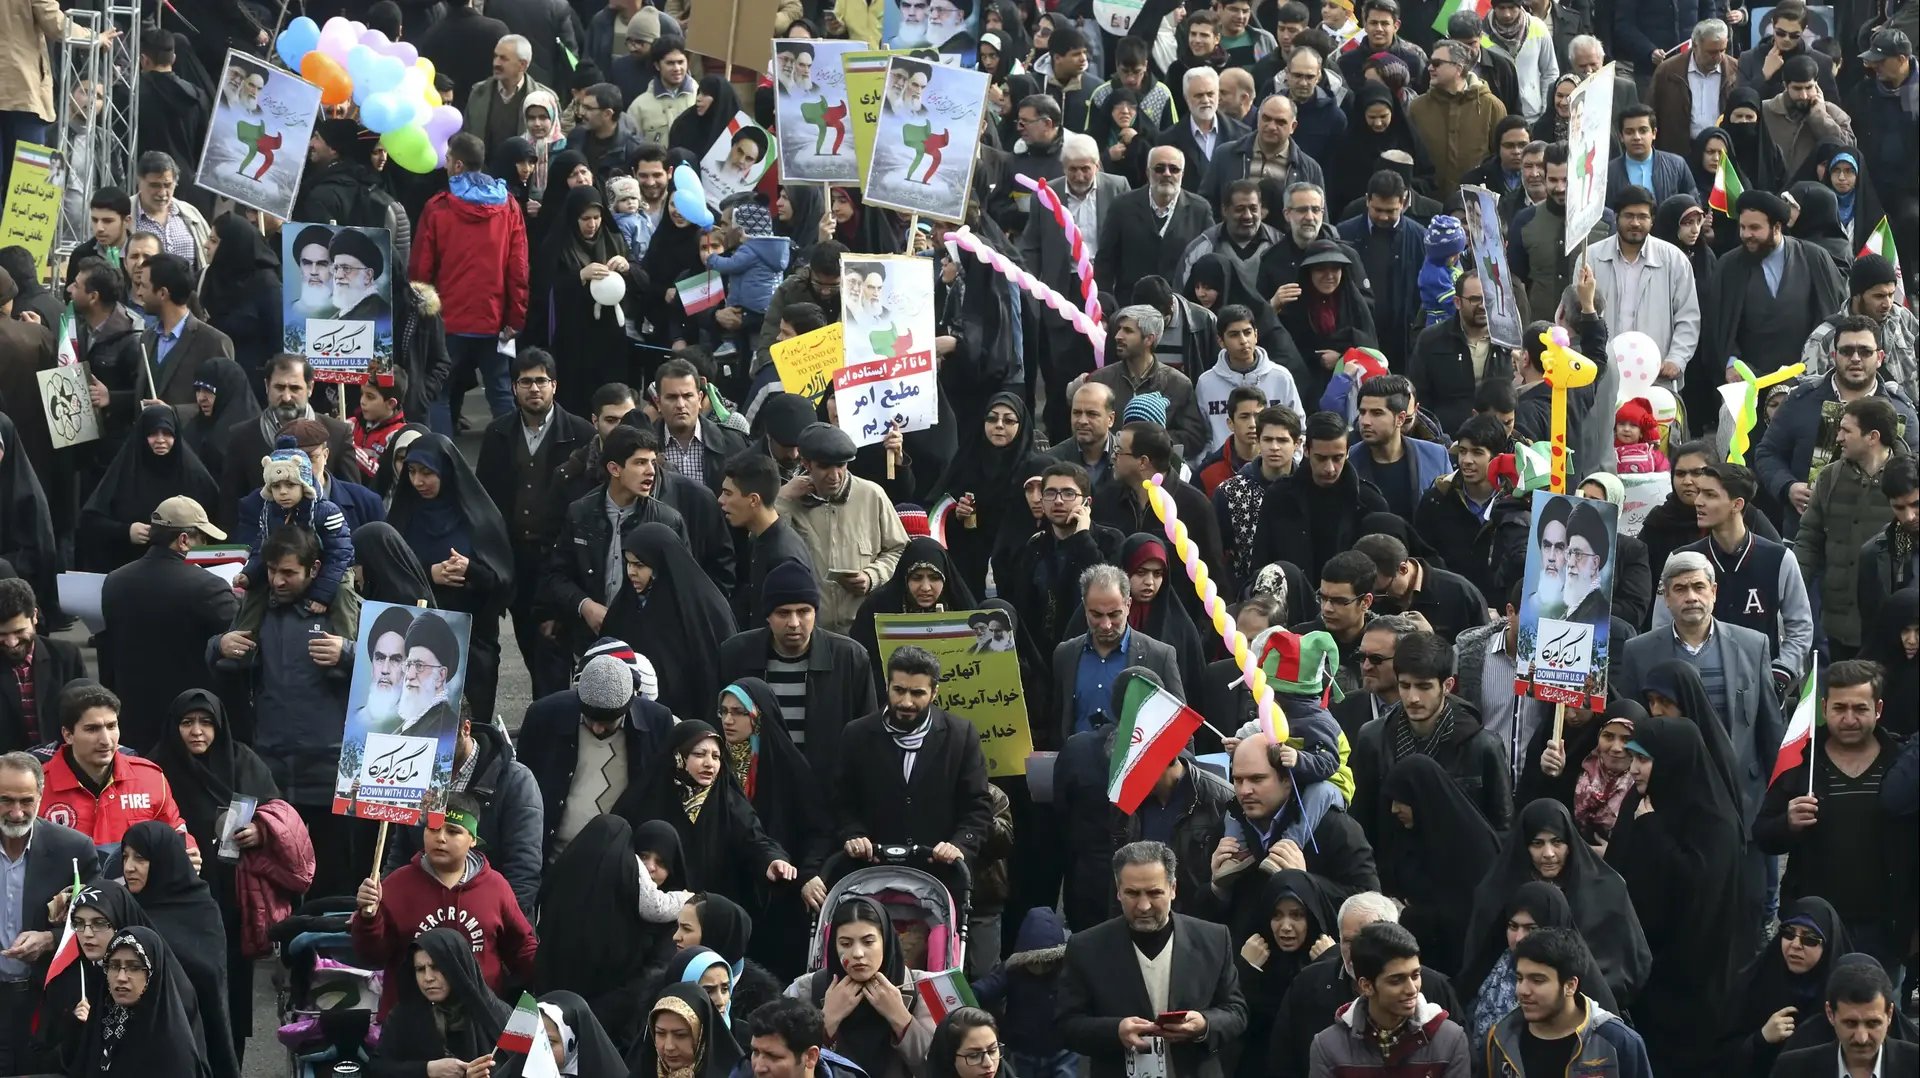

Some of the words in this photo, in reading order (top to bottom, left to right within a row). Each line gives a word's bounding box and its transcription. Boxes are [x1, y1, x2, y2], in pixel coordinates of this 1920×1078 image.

[309, 358, 330, 366] DOWN
[791, 357, 801, 367] WE
[805, 350, 826, 362] STAND
[826, 347, 836, 356] UP
[797, 367, 808, 376] TO
[808, 361, 822, 371] THE
[823, 356, 838, 367] END
[890, 356, 908, 377] آخر
[909, 356, 917, 369] تا
[918, 355, 927, 367] ما
[838, 370, 851, 388] ایم
[852, 362, 887, 380] ایستاده
[852, 385, 876, 416] امر
[880, 380, 920, 409] مطیع
[1743, 588, 1764, 614] A
[938, 660, 981, 683] آنهایی
[1536, 669, 1556, 680] DOWN
[1555, 671, 1570, 681] WITH
[948, 689, 986, 710] آمریکا
[987, 688, 1019, 707] خواب
[993, 723, 1017, 738] خدا
[120, 793, 151, 810] FIRE
[361, 786, 382, 797] DOWN
[384, 788, 402, 798] WITH
[403, 789, 422, 799] U.S.A
[414, 906, 484, 952] ERCROMBIE
